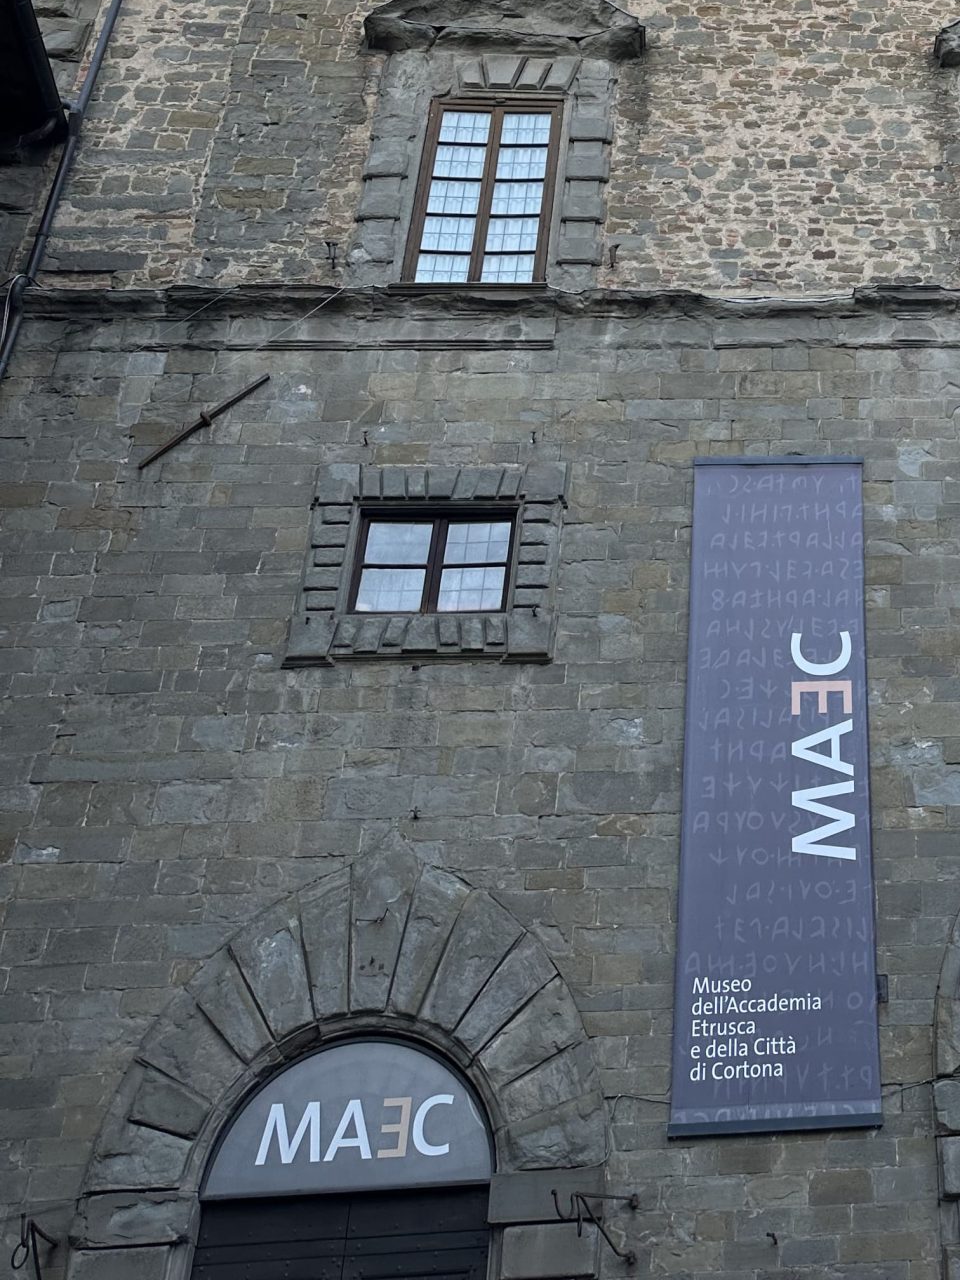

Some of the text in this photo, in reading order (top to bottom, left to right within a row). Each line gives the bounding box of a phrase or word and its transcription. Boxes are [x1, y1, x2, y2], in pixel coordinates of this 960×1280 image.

[791, 631, 857, 860] MAEC
[692, 976, 752, 994] Museo
[692, 1019, 756, 1037] Etrusca
[690, 1035, 796, 1059] e della Città
[689, 1061, 783, 1081] di Cortona
[255, 1094, 455, 1166] MAEC
